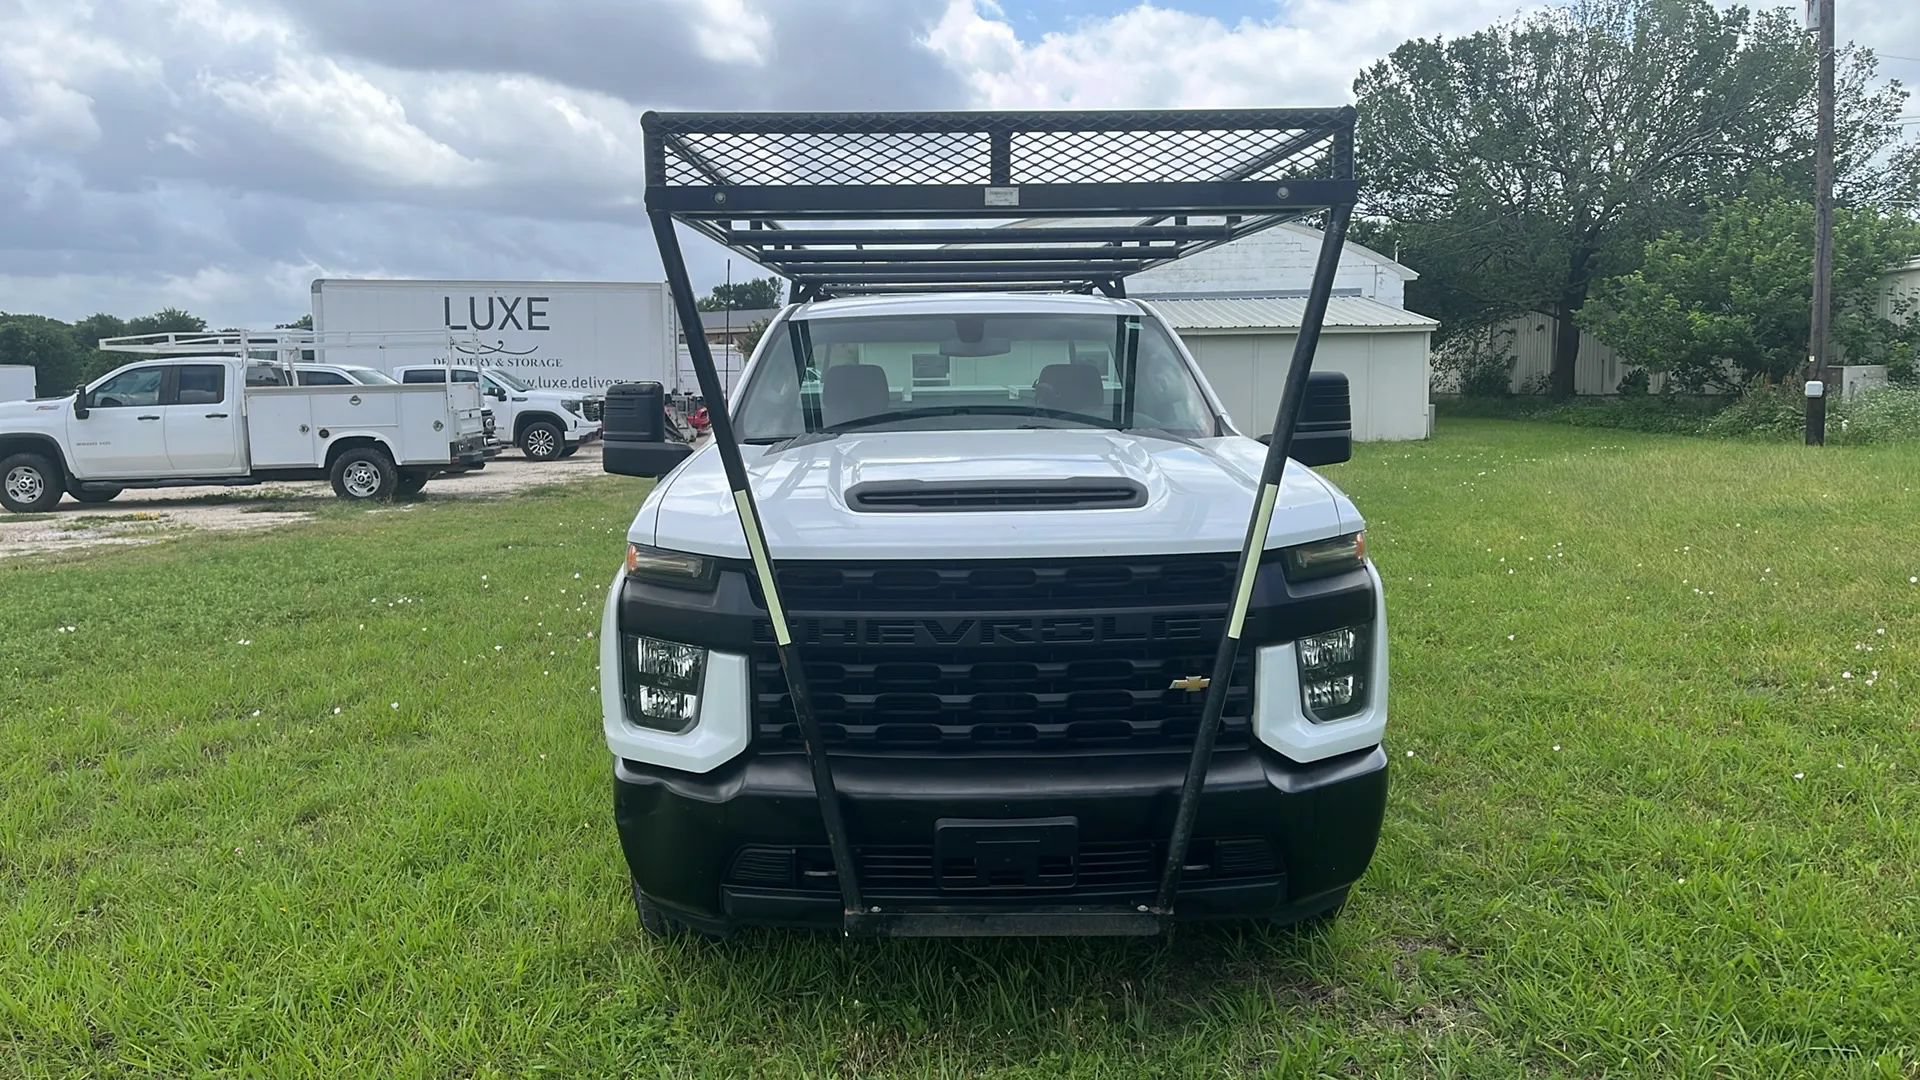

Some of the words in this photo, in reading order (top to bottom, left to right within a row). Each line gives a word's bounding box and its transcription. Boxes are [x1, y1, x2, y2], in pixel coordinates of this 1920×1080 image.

[444, 296, 550, 331] LUXE
[433, 358, 493, 368] DEIVERY
[495, 358, 504, 368] &
[507, 358, 564, 368] STORAGE
